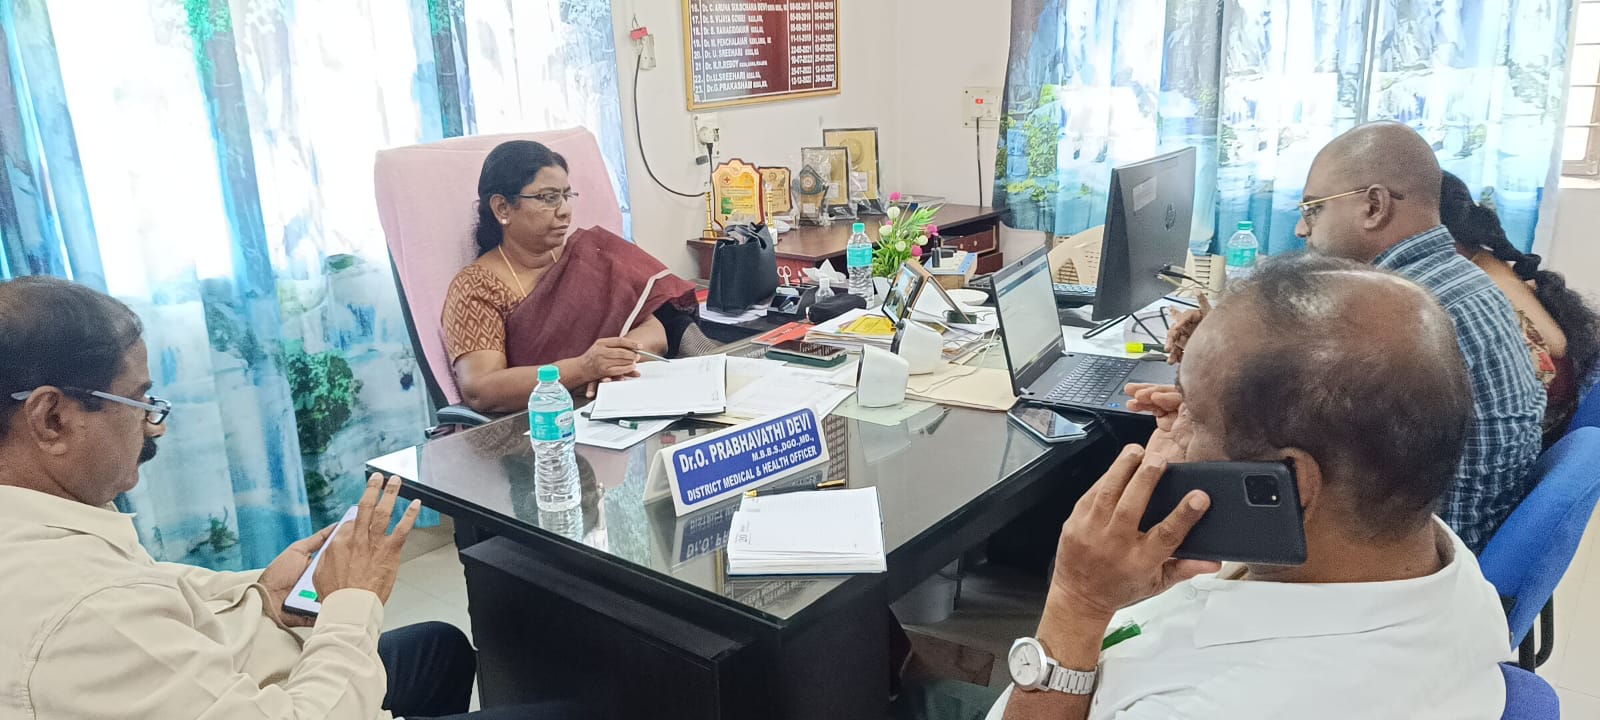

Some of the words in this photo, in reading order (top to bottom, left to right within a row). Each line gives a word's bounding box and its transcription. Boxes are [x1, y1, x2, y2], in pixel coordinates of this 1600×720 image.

[678, 448, 709, 474] Dr.O.
[709, 420, 786, 465] PRABHAVATHI
[787, 412, 812, 437] DEVI
[686, 478, 722, 502] DISTRICT
[723, 469, 755, 490] MEDICAL
[756, 468, 762, 478] &
[762, 457, 790, 474] HEALTH
[790, 445, 818, 464] OFFICER
